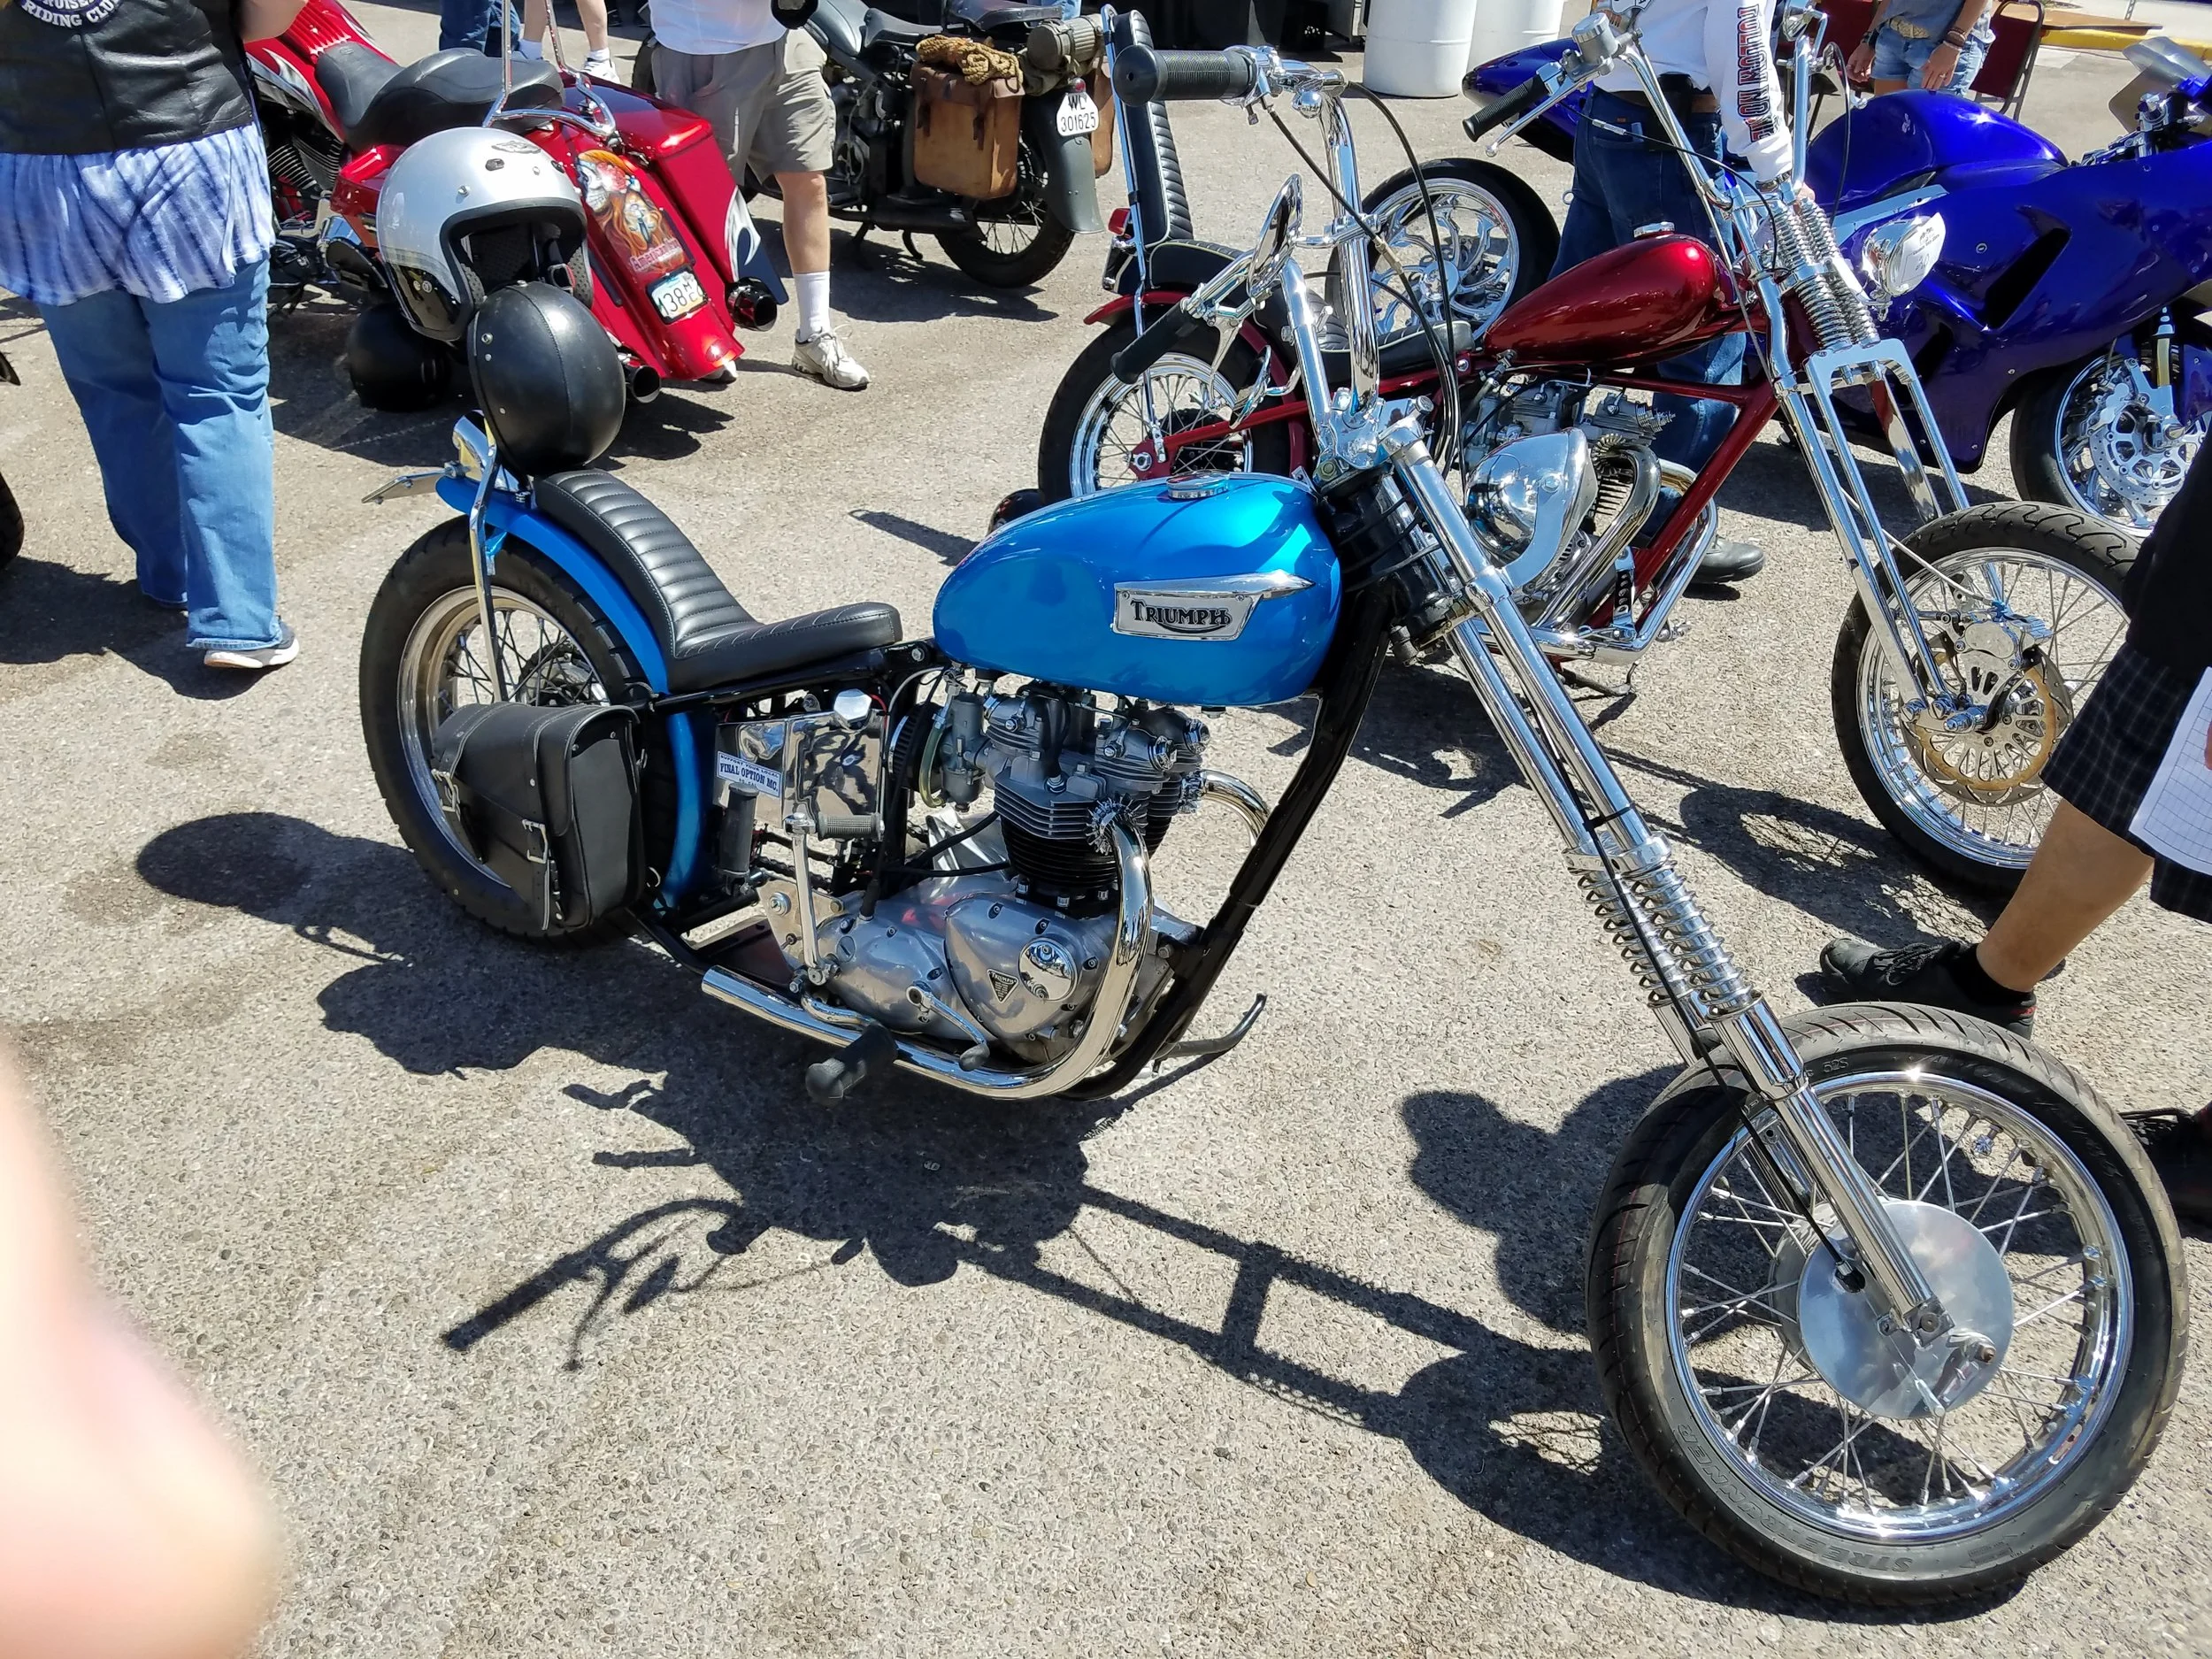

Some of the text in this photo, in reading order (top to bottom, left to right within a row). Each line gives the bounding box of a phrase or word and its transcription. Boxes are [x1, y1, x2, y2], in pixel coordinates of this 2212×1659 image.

[21, 1, 82, 27] RIDING
[1737, 4, 1769, 86] FOLLOW
[1060, 111, 1096, 133] 301625
[1130, 598, 1233, 629] TRIUMPH
[720, 763, 740, 775] FINAL
[741, 767, 765, 785] OPTION
[761, 769, 779, 778] LOCAL
